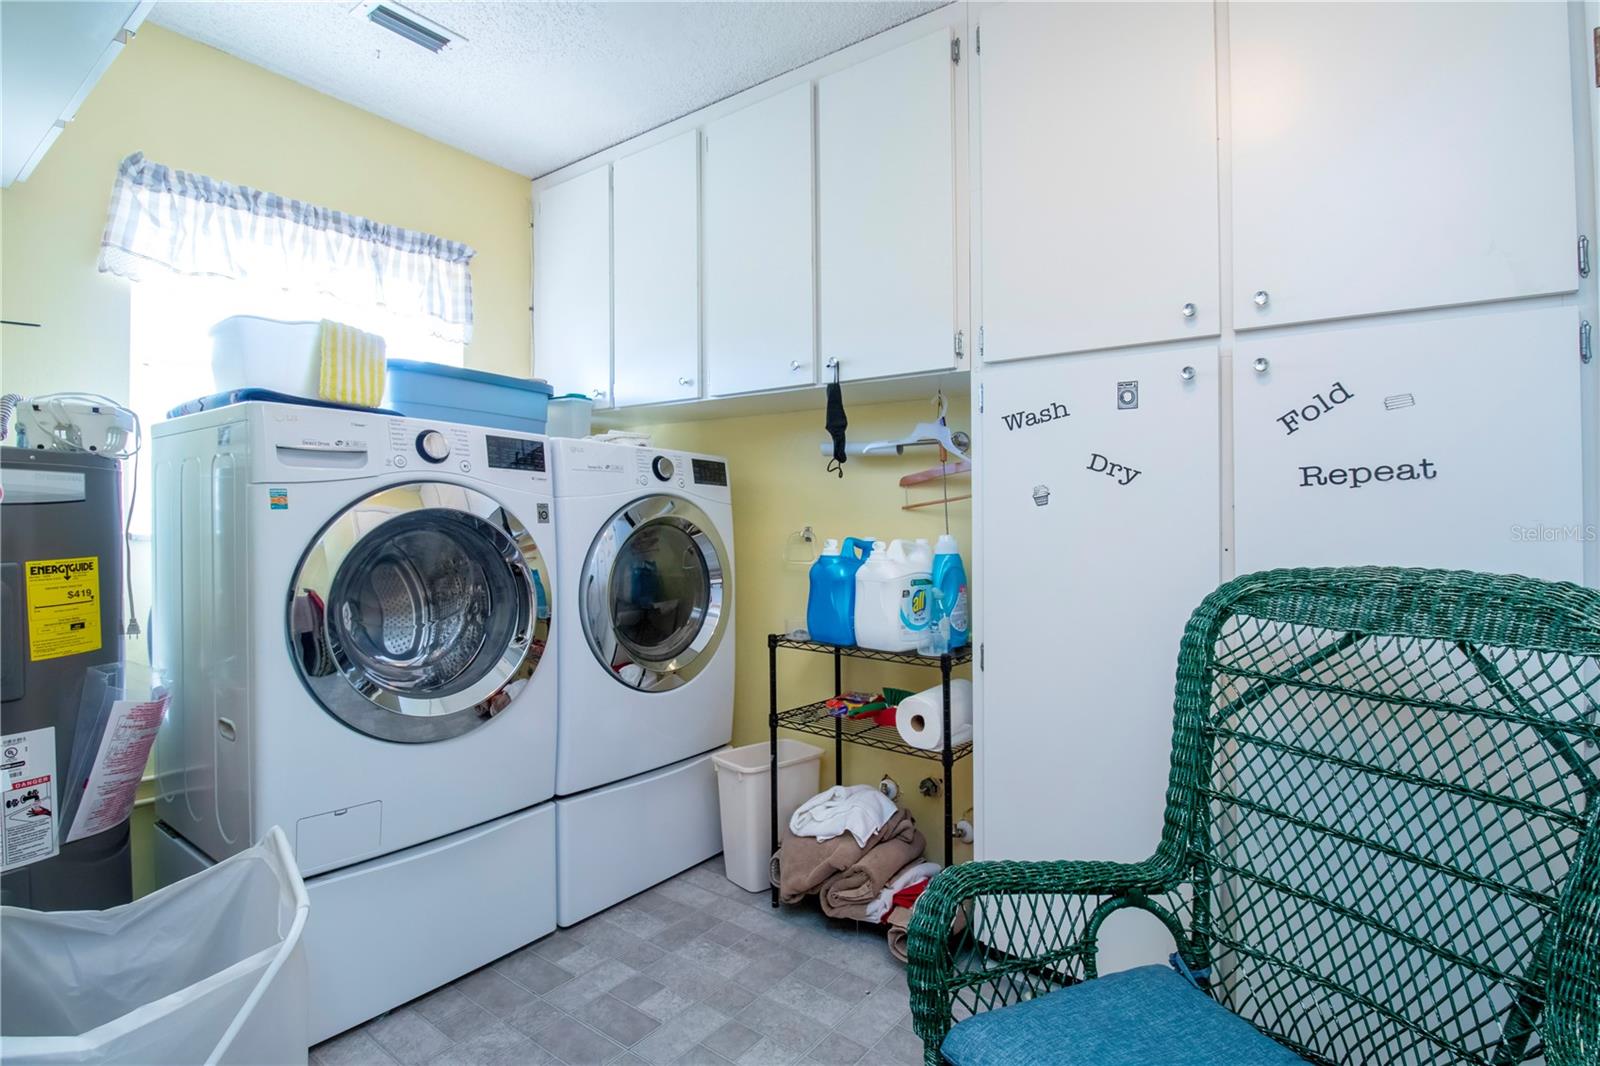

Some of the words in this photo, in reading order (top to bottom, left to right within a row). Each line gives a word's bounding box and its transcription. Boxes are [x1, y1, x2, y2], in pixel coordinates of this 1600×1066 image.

[1001, 402, 1071, 431] Wash
[1276, 381, 1355, 436] Fold
[1086, 453, 1142, 486] Dry
[1298, 458, 1437, 489] Repeat
[30, 562, 94, 577] ENERGYGUIDE
[67, 588, 92, 599] $419
[912, 590, 925, 612] all
[15, 777, 49, 789] DANGER
